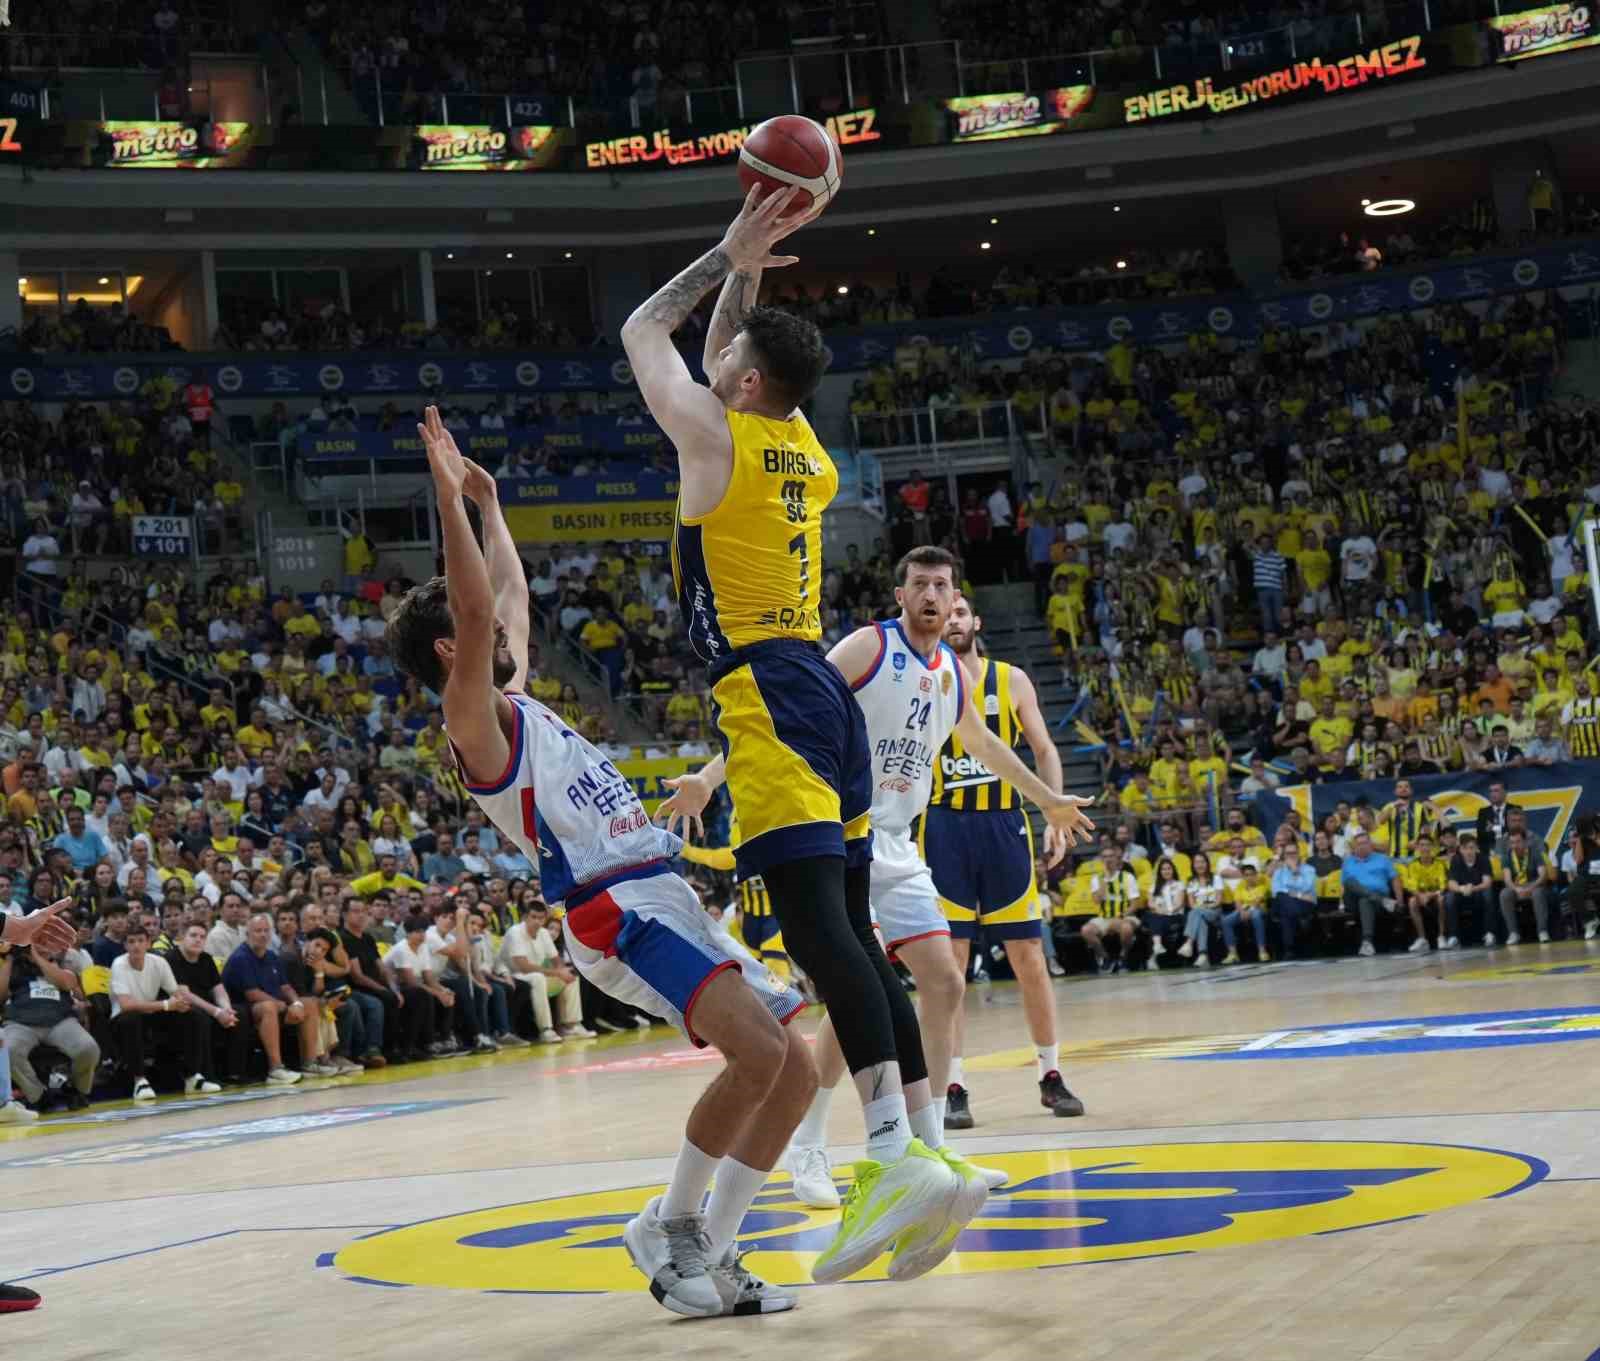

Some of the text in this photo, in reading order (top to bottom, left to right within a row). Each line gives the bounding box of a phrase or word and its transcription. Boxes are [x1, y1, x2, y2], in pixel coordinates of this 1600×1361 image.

[1320, 35, 1426, 93] DEMEZ
[514, 102, 543, 116] 422
[112, 127, 198, 160] metro
[426, 131, 506, 162] metro
[517, 485, 559, 497] BASIN
[152, 519, 183, 534] 201
[552, 514, 605, 530] BASIN
[621, 511, 673, 527] PRESS
[156, 538, 185, 553] 101
[905, 697, 932, 731] 24
